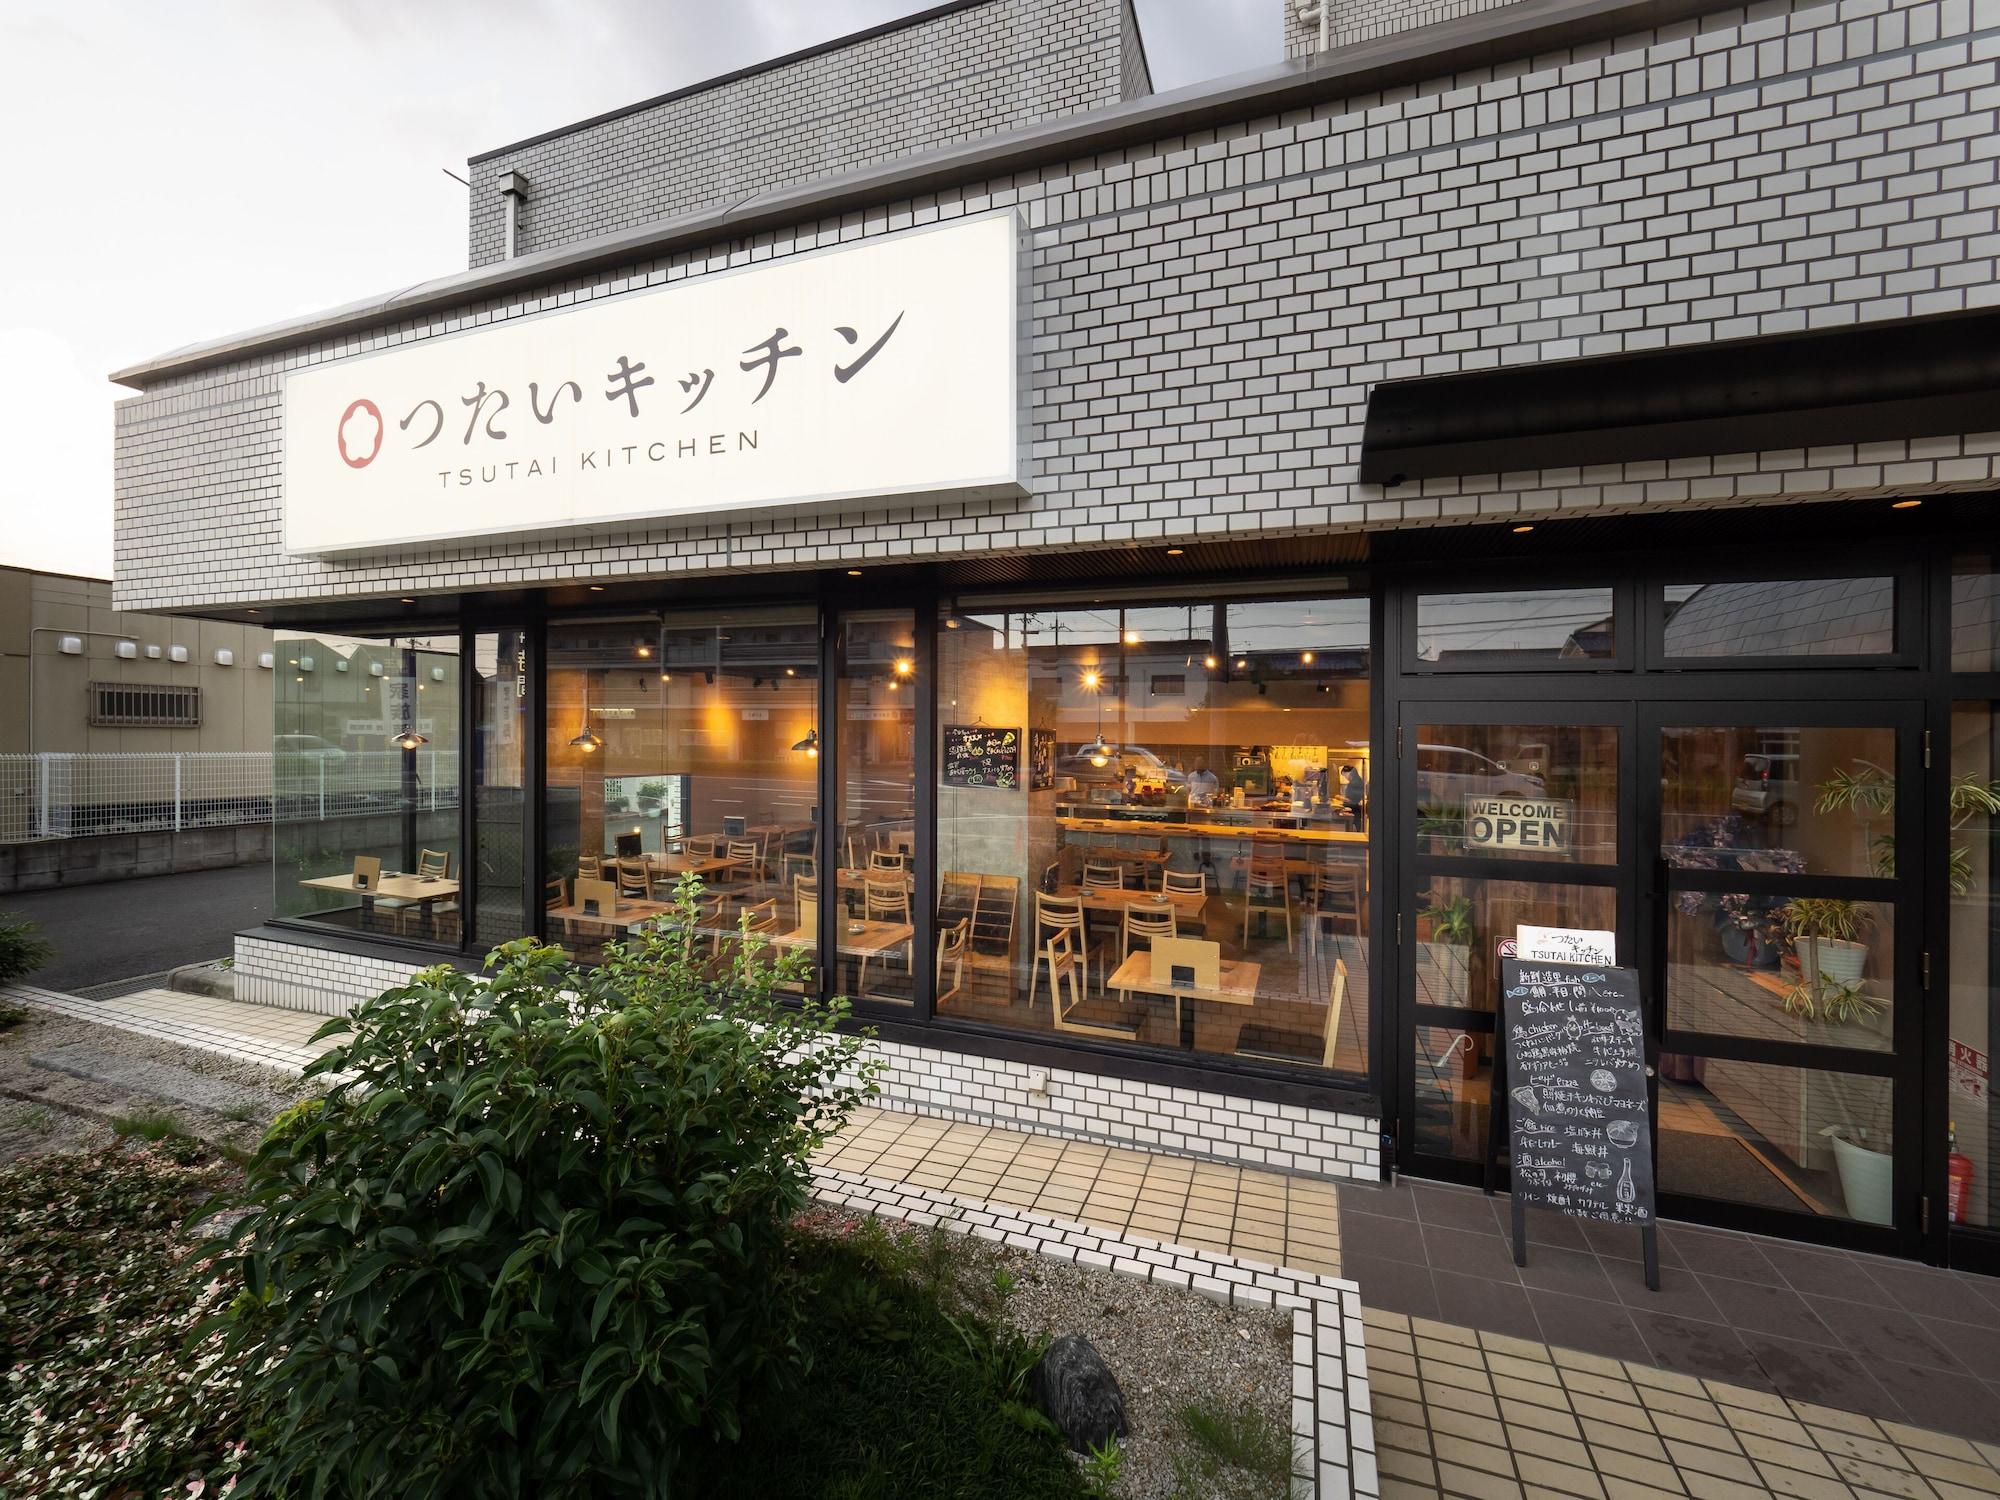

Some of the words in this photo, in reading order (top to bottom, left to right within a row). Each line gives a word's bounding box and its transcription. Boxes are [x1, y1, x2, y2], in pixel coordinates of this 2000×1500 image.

[399, 309, 905, 449] つたいキッチン
[439, 457, 558, 489] TSUTAI
[581, 429, 759, 470] KITCHEN
[1472, 802, 1564, 819] WELCOME
[1472, 816, 1567, 848] OPEN
[1552, 933, 1583, 944] つたい
[1571, 944, 1603, 955] キッチン
[1531, 950, 1566, 961] TSUTAI
[1569, 953, 1612, 966] KITCHEN
[1516, 1153, 1532, 1166] 酒
[1534, 1156, 1566, 1167] alcohol
